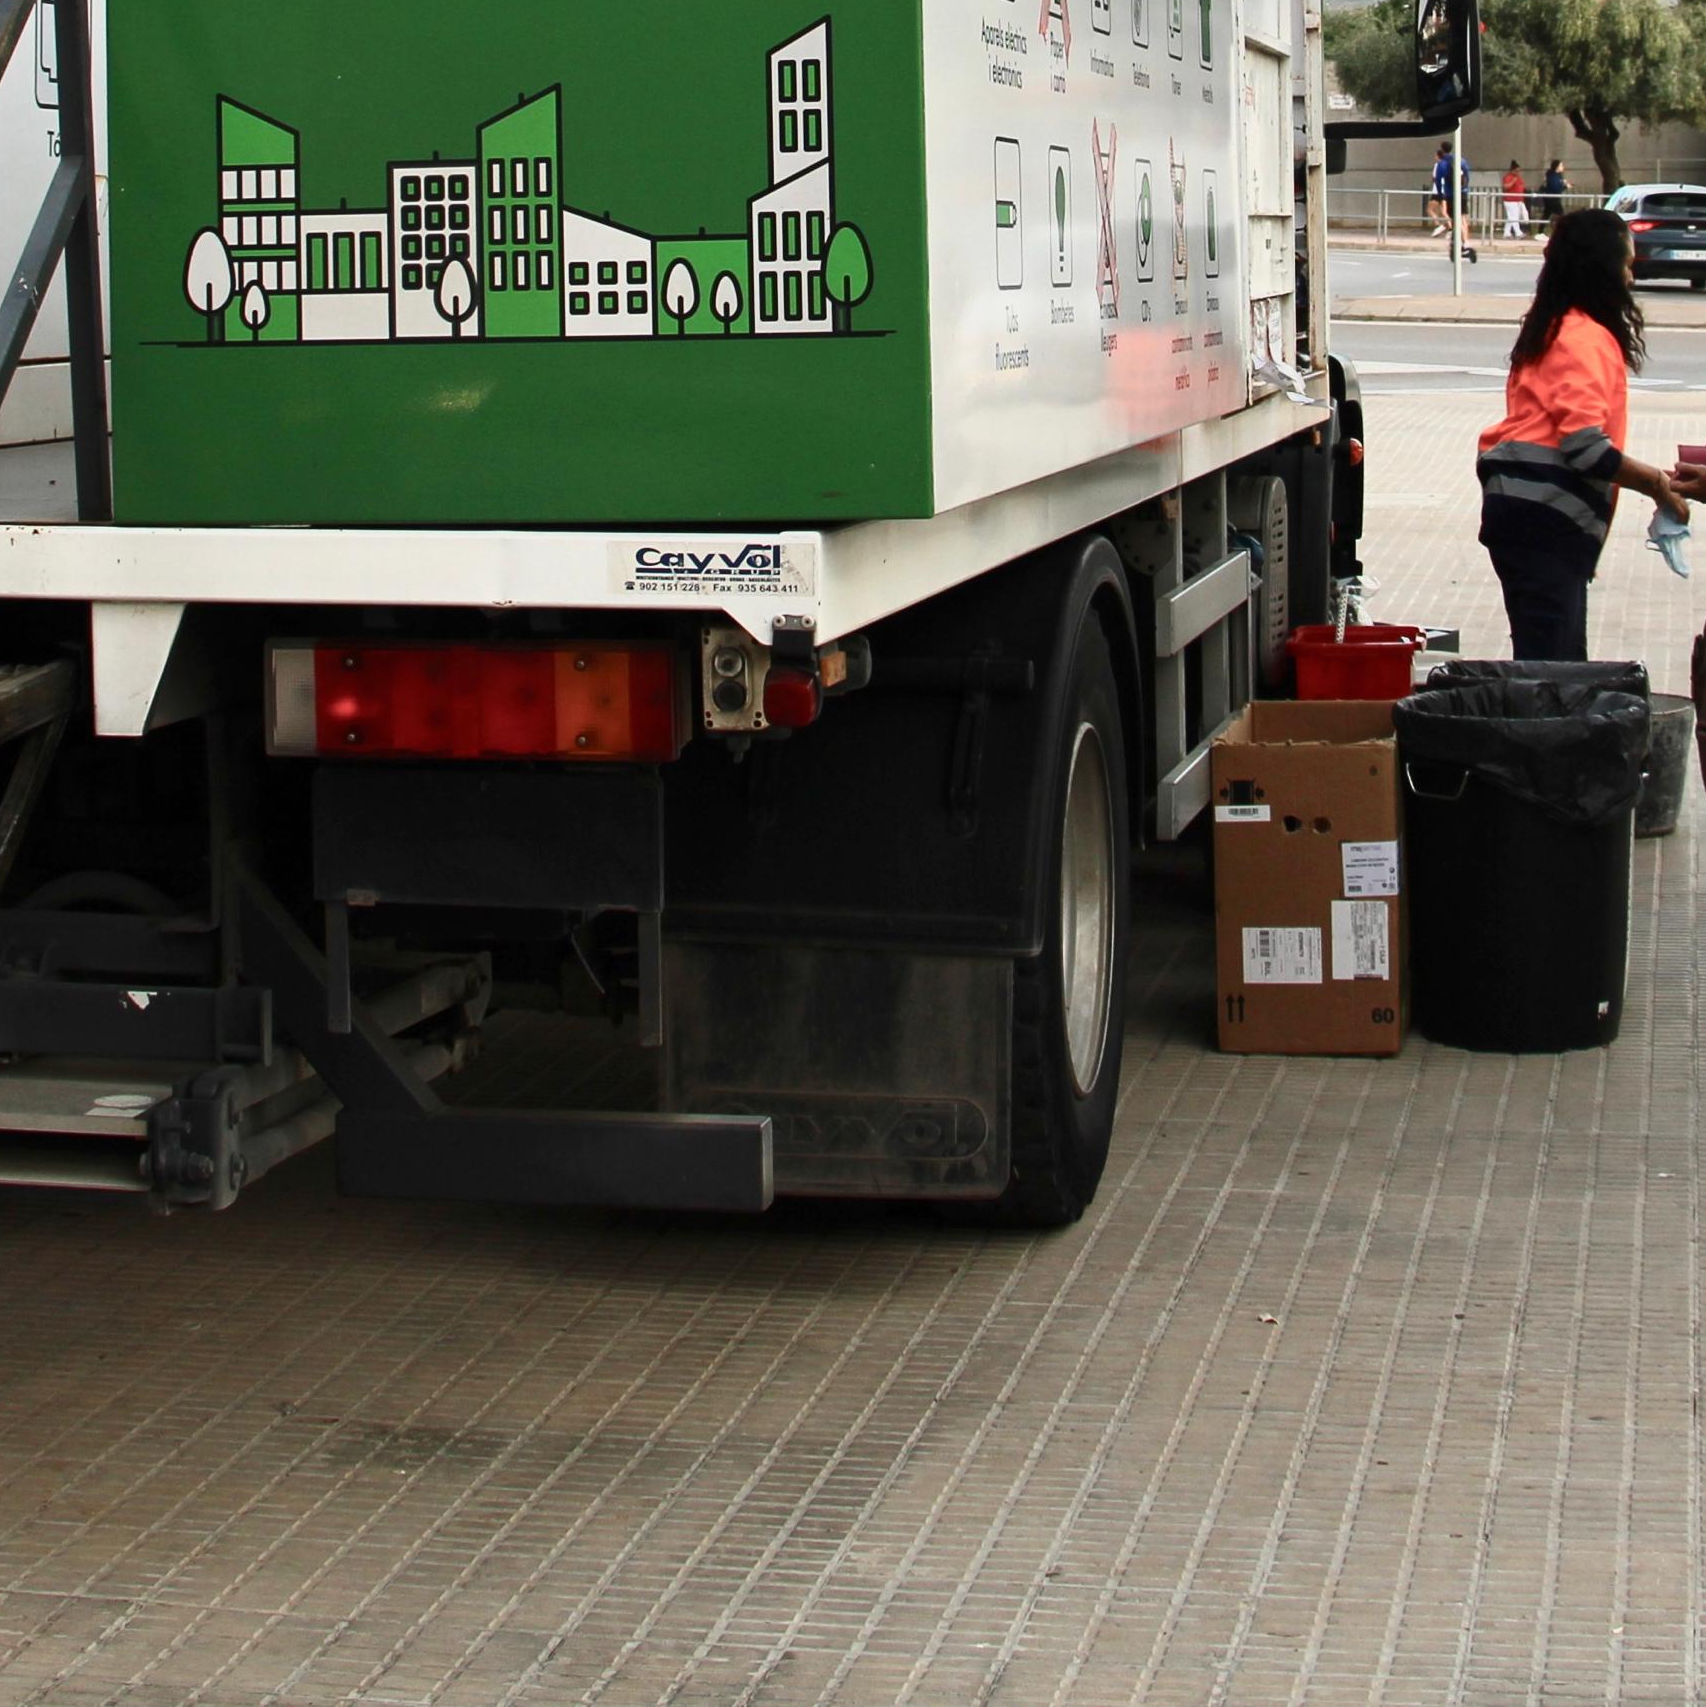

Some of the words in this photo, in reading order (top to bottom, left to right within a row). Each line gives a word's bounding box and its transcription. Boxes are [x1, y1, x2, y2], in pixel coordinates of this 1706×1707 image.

[639, 582, 658, 591] 902
[661, 582, 678, 591] 151
[681, 583, 700, 592] 228
[713, 584, 732, 592] Fax
[737, 584, 756, 592] 935
[780, 584, 798, 592] 411
[1371, 1007, 1395, 1024] 60
